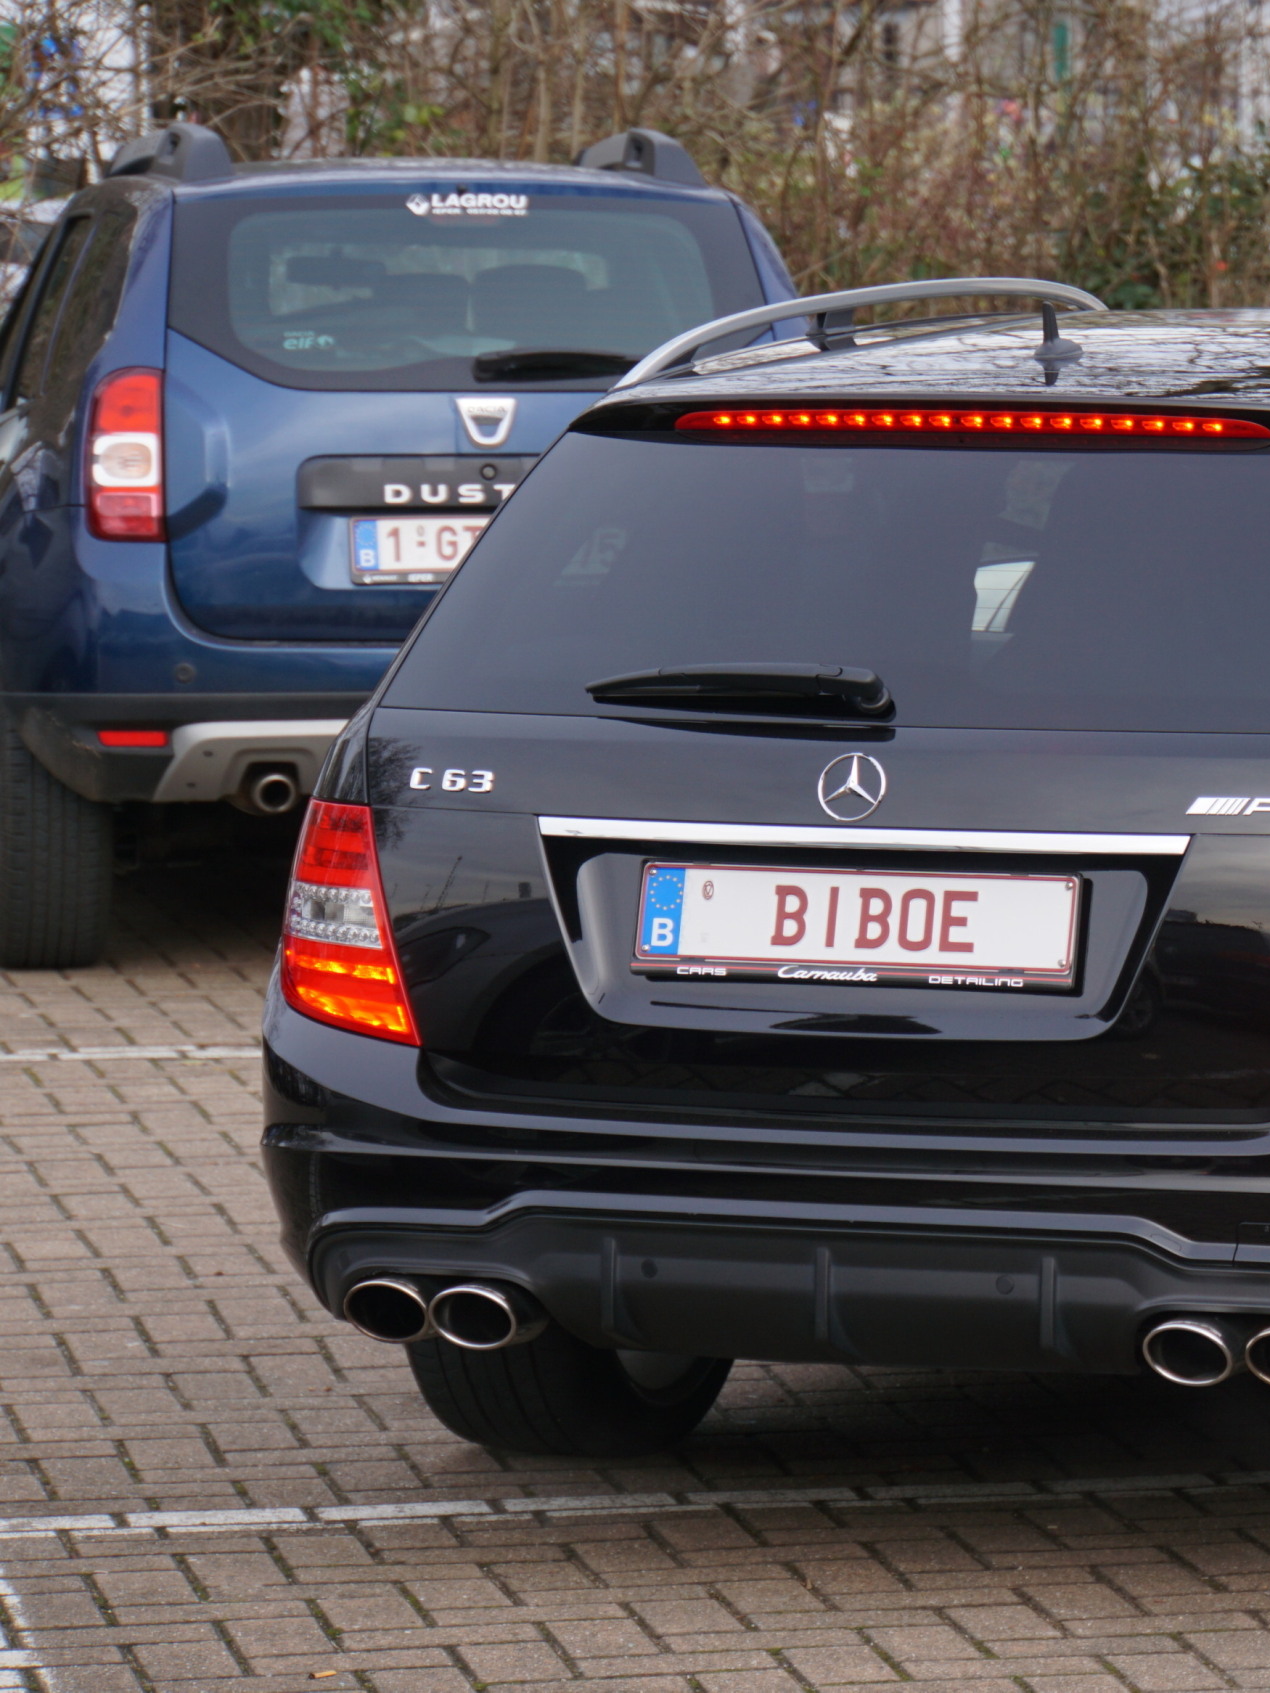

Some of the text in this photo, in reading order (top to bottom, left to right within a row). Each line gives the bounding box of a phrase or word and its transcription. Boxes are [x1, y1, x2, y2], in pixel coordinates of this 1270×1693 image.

[431, 193, 529, 209] LAGROU
[283, 337, 315, 350] elf
[360, 550, 375, 567] B
[409, 767, 495, 793] C 63
[770, 885, 980, 953] BIBOE
[650, 917, 675, 947] B
[676, 964, 1024, 988] CARS Carnauba DETAILING
